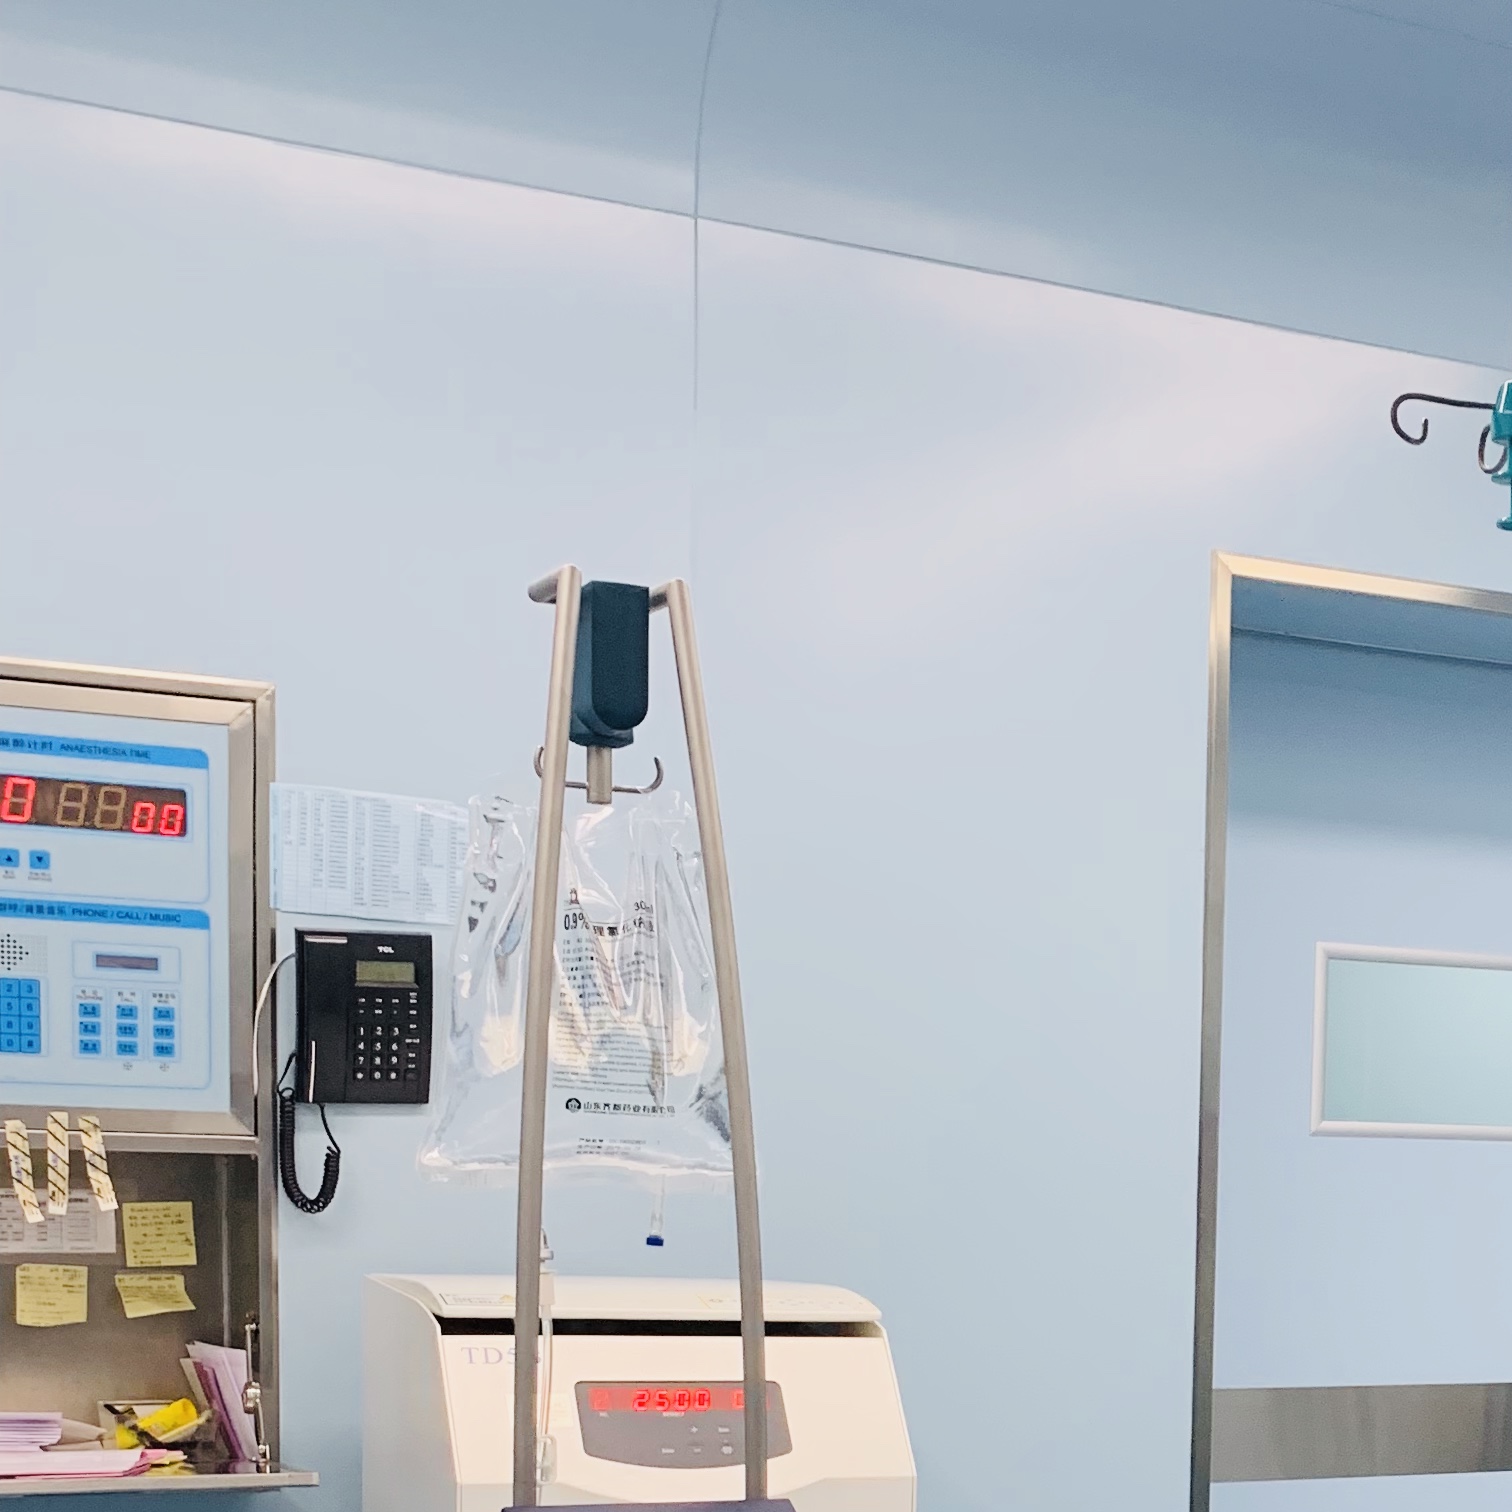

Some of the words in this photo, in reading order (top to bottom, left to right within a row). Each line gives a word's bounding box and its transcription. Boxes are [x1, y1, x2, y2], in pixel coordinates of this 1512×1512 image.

[60, 743, 127, 757] ANAESTHESIA
[131, 801, 185, 836] 00
[72, 908, 108, 919] PHONE
[116, 910, 141, 920] CALL
[149, 912, 182, 923] MUSIC
[377, 945, 395, 954] TCL
[375, 1026, 382, 1036] 2
[393, 1027, 400, 1036] 3
[633, 1388, 711, 1412] 2500
